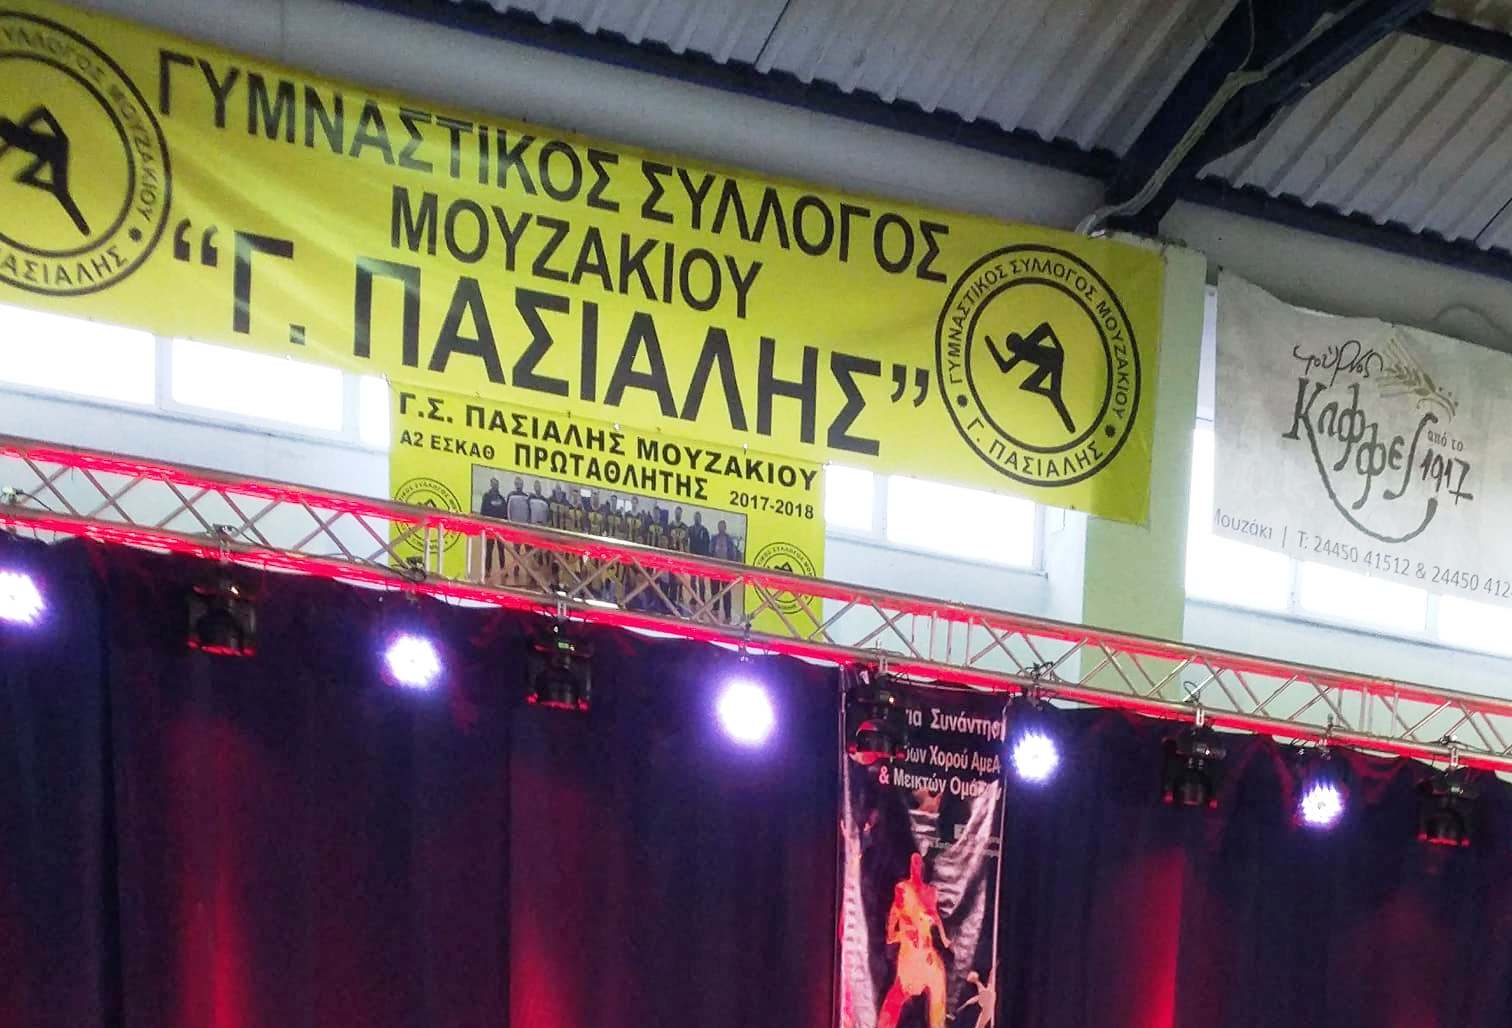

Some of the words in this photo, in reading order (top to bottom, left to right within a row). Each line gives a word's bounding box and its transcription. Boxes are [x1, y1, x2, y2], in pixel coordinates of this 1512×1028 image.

[158, 50, 619, 212] ΓΥΜΝΑΣΤΙΚΟΣ
[641, 160, 949, 283] ΣΥΛΛΟΓΟΣ
[1, 245, 128, 285] ΑΣΙΑΛΗΣ
[391, 184, 762, 319] ΜΟΥΖΑΚΙΟΥ
[950, 265, 1009, 384] ΓΥΜΝΑΣΤΙΚΟΣ
[1009, 258, 1097, 301] ΣΥΛΛΟΓΟΣ
[1095, 301, 1129, 419] ΜΟΥΖΑΚΙΟΥ
[399, 392, 453, 423] Γ.Σ.
[465, 404, 626, 456] ΠΑΣΙΑΛΗΣ
[636, 437, 817, 491] ΜΟΥΖΑΚΙΟΥ
[988, 440, 1104, 477] ΠΑΣΙΑΛΗΣ
[430, 434, 495, 460] ΕΣΚΑΘ
[514, 443, 708, 500] ΠΡΩΤΑΘΛΗΤΗΣ
[729, 490, 815, 520] 2017-2018
[1421, 448, 1474, 505] 1917
[1313, 534, 1358, 564] 24450
[1363, 550, 1411, 577] 41512
[1415, 563, 1426, 579] &
[1431, 566, 1479, 591] 24450
[878, 765, 889, 785] &
[893, 767, 946, 795] Μεικτών
[929, 745, 968, 772] Χορού
